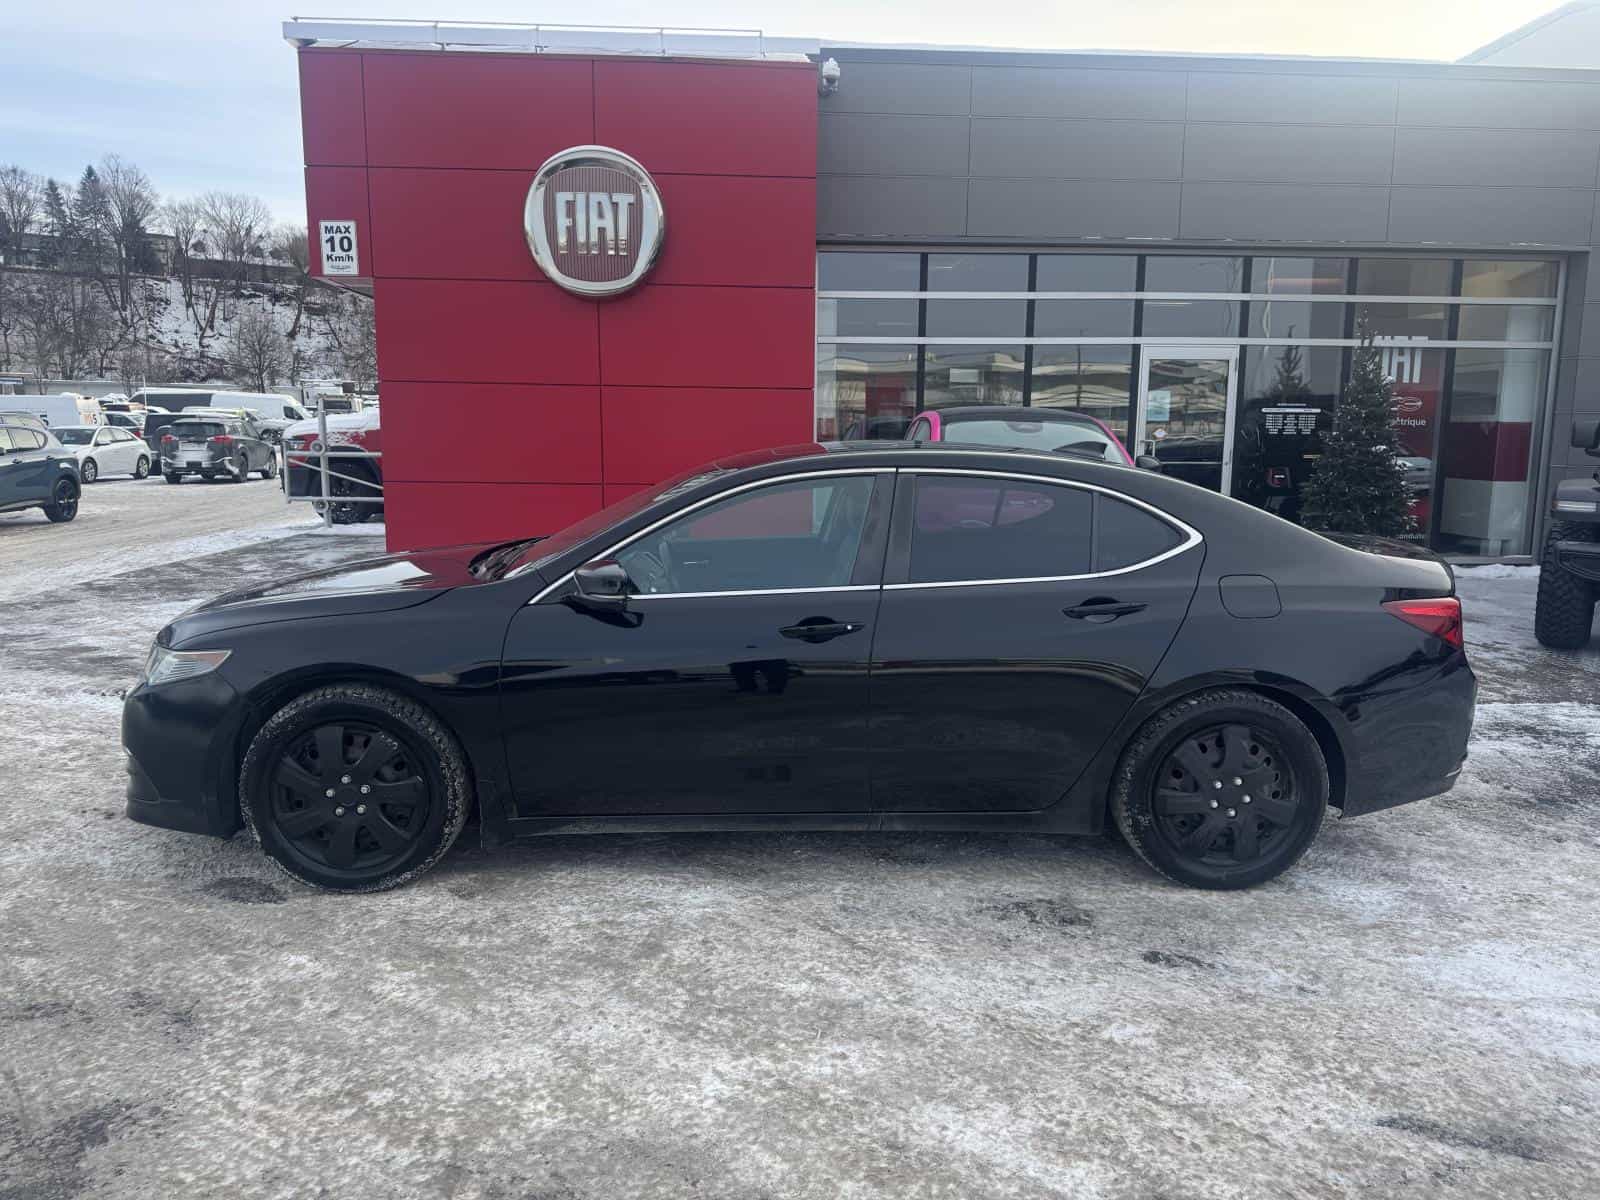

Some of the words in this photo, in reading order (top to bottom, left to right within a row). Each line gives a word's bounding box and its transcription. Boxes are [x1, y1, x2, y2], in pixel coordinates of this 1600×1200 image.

[324, 225, 351, 234] MAX
[554, 191, 635, 256] FIAT
[325, 235, 353, 253] 10
[326, 254, 354, 263] Km/h
[1371, 335, 1429, 384] IAT
